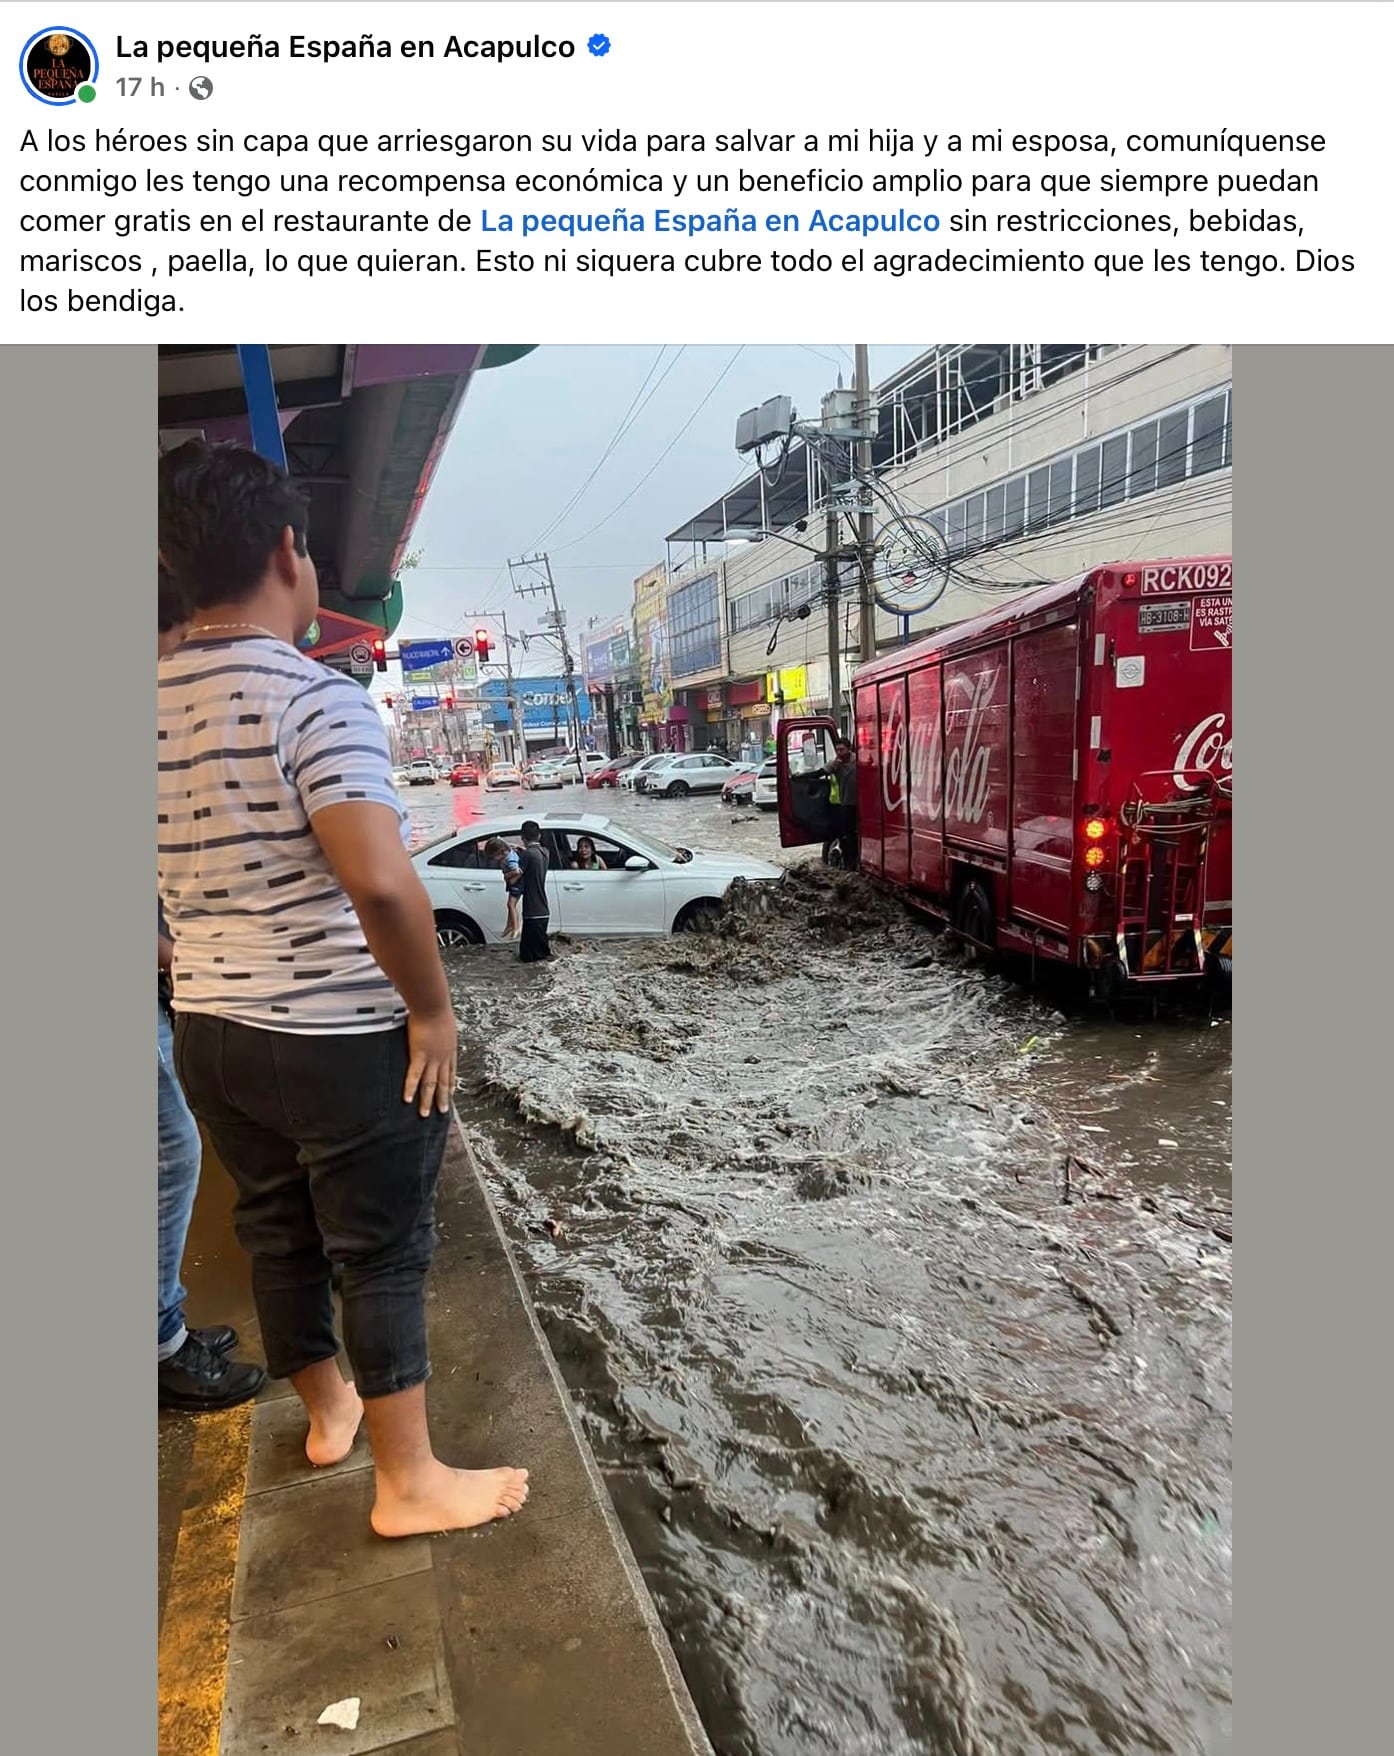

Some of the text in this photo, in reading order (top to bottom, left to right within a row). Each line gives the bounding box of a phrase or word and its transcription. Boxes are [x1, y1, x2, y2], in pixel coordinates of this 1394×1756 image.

[1200, 598, 1221, 608] ESTA
[1195, 608, 1206, 617] ES
[1199, 617, 1213, 627] VÍA
